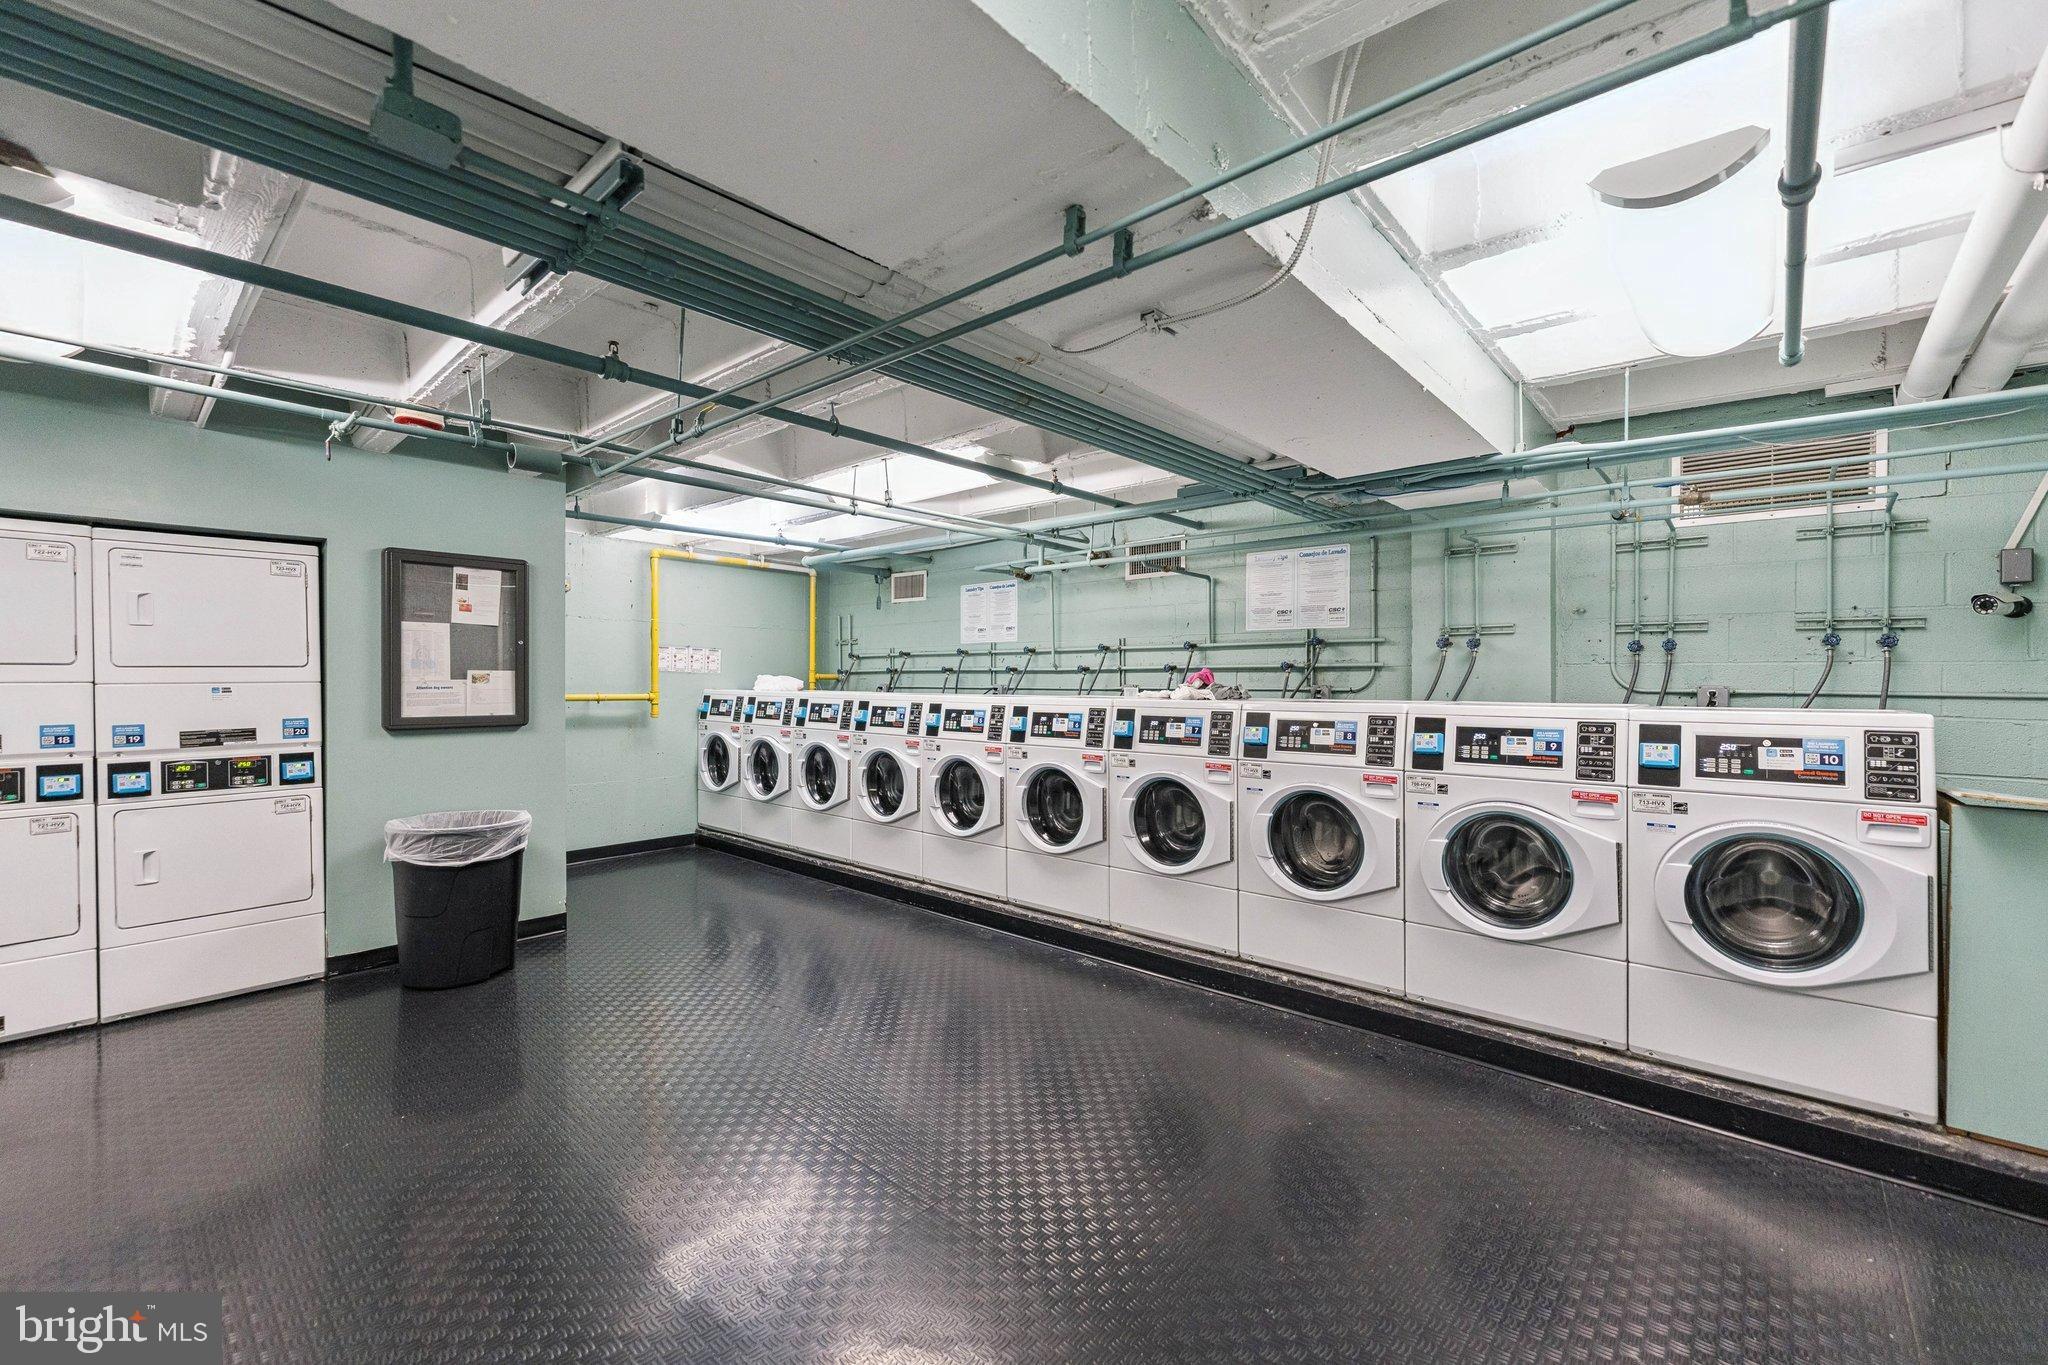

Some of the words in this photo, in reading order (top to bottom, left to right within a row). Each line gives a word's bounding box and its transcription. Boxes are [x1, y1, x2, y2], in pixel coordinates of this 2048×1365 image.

[1299, 550, 1320, 558] Consejos
[57, 736, 70, 744] 18
[1346, 732, 1352, 740] 8
[1550, 742, 1557, 751] 9
[1822, 755, 1839, 765] 10
